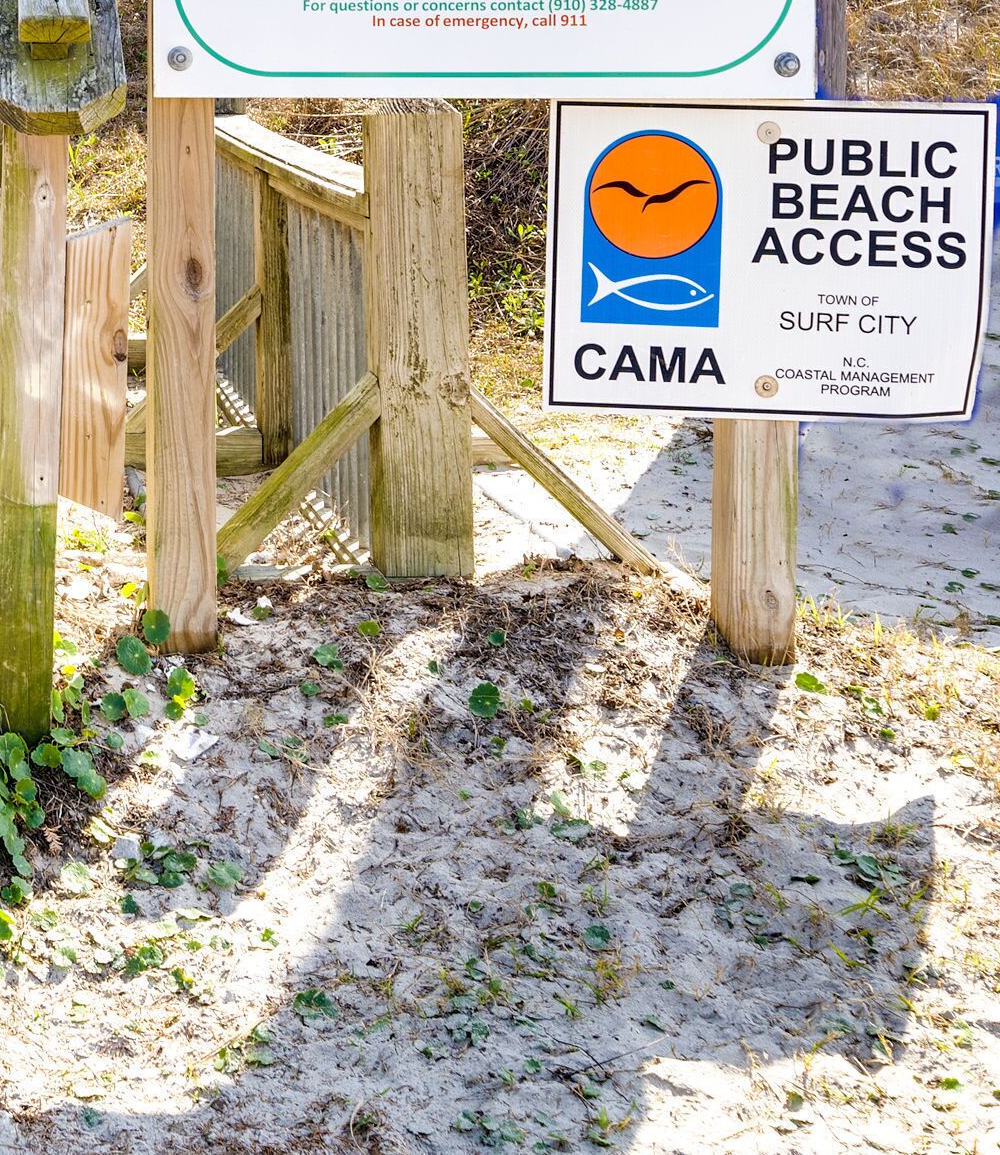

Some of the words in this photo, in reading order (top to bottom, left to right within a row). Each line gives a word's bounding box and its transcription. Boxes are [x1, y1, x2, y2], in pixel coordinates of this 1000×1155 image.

[302, 0, 327, 12] For
[402, 1, 420, 12] or
[421, 1, 487, 12] concerns
[489, 0, 545, 12] contact
[372, 14, 386, 27] In
[389, 17, 421, 28] case
[424, 13, 441, 27] of
[442, 17, 529, 30] emergency,
[531, 13, 557, 27] call
[560, 13, 588, 27] 911
[768, 137, 958, 179] PUBLIC
[771, 182, 951, 224] BEACH
[751, 226, 967, 270] ACCESS
[817, 294, 857, 306] TOWN
[861, 295, 879, 307] OF
[779, 310, 850, 332] SURF
[858, 314, 918, 335] CITY
[574, 343, 726, 385] CAMA
[843, 357, 870, 368] N.C.
[773, 368, 837, 381] COASTAL
[840, 370, 935, 384] MANAGEMENT
[821, 384, 891, 397] PROGRAM
